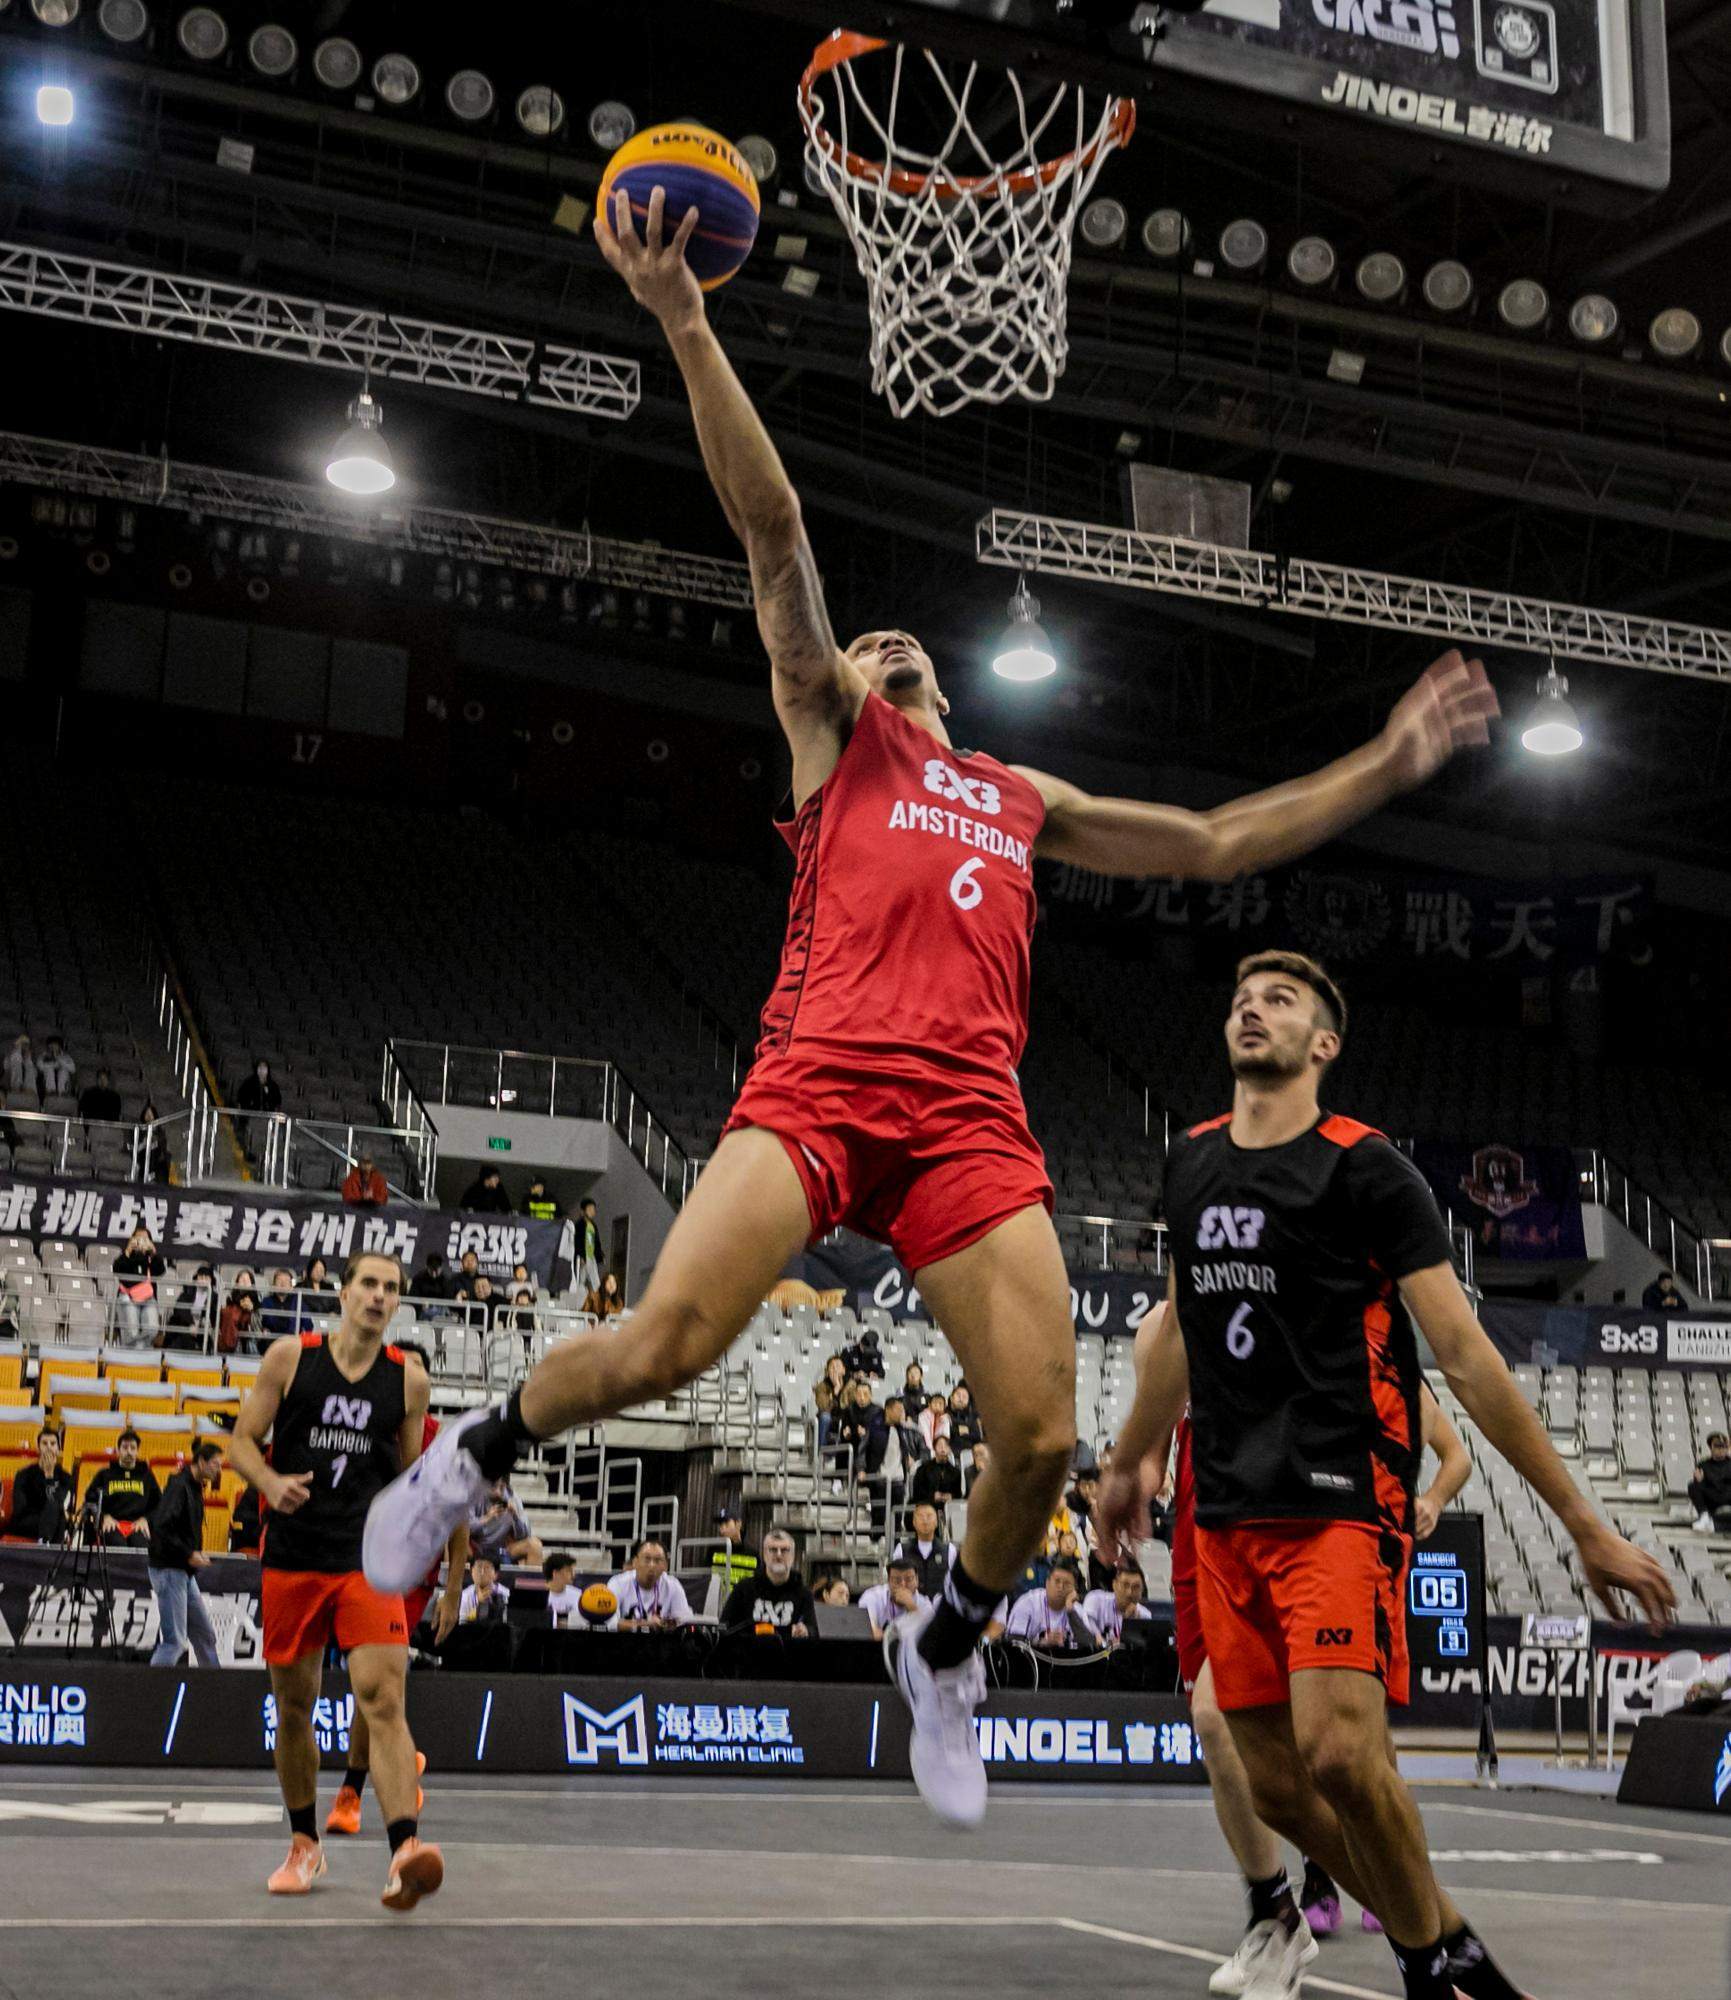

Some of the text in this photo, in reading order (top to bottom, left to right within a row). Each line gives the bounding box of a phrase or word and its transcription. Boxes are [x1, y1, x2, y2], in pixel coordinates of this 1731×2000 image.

[1321, 70, 1465, 135] JINOEL
[888, 800, 1029, 874] AMSTERDAM
[949, 856, 986, 911] 6
[1226, 1301, 1257, 1360] 6
[656, 1702, 793, 1744] 海曼康复
[973, 1716, 1123, 1764] INOEL
[654, 1744, 805, 1764] HEALMAN CLINIC
